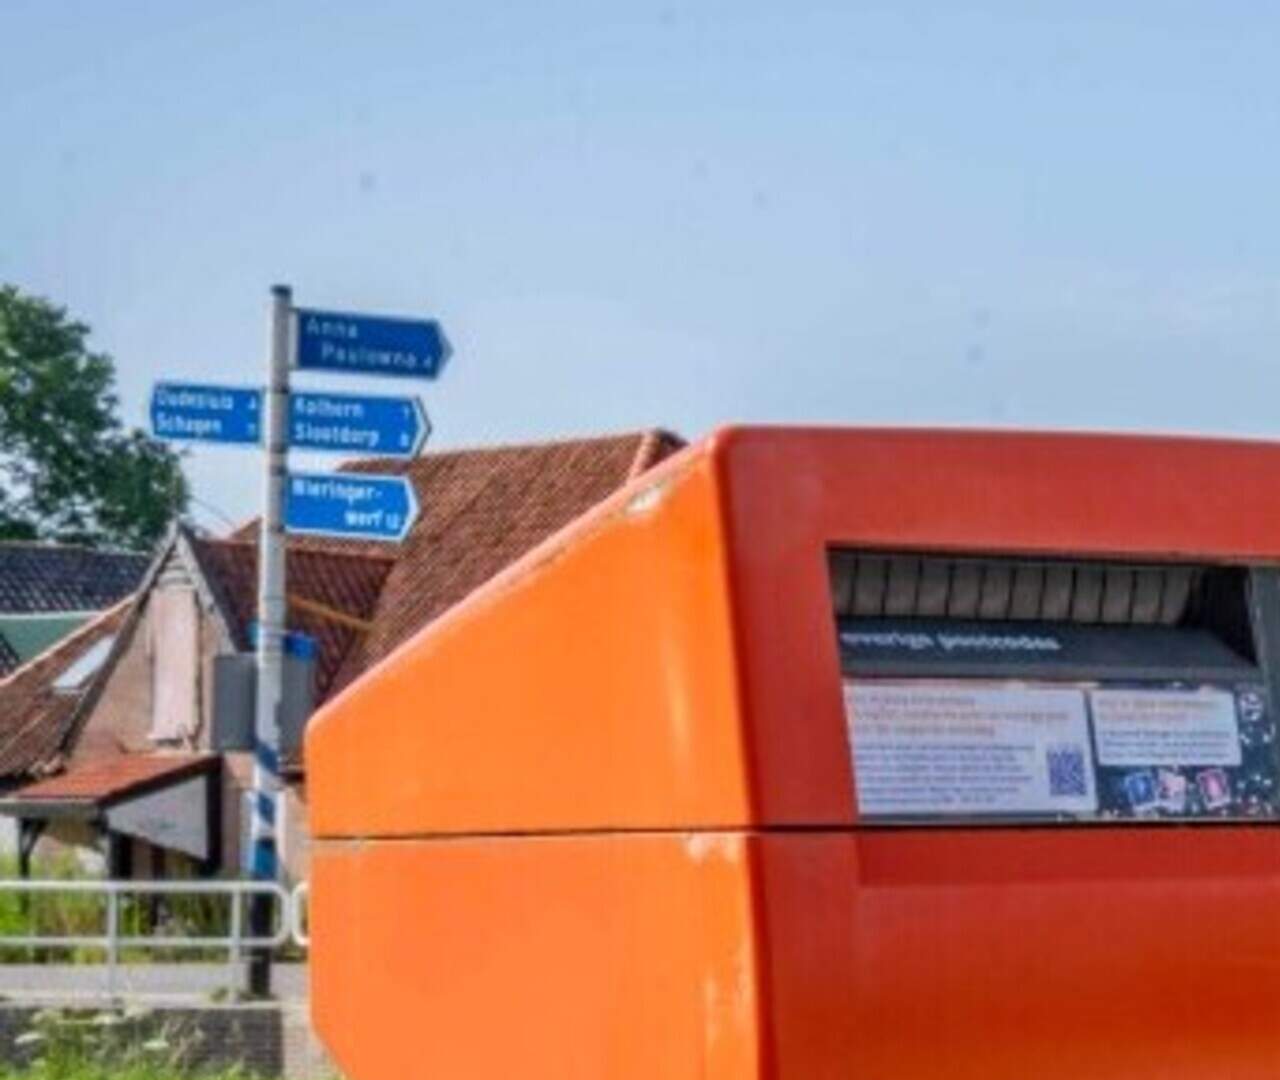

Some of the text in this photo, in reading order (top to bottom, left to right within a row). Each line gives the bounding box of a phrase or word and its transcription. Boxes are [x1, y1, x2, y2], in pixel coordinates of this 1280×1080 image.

[307, 317, 359, 340] Anna
[321, 344, 417, 370] Paulowna
[156, 413, 223, 435] Schagen
[295, 422, 381, 448] Slootdorp
[344, 508, 382, 530] werf
[937, 631, 1064, 653] postcodes
